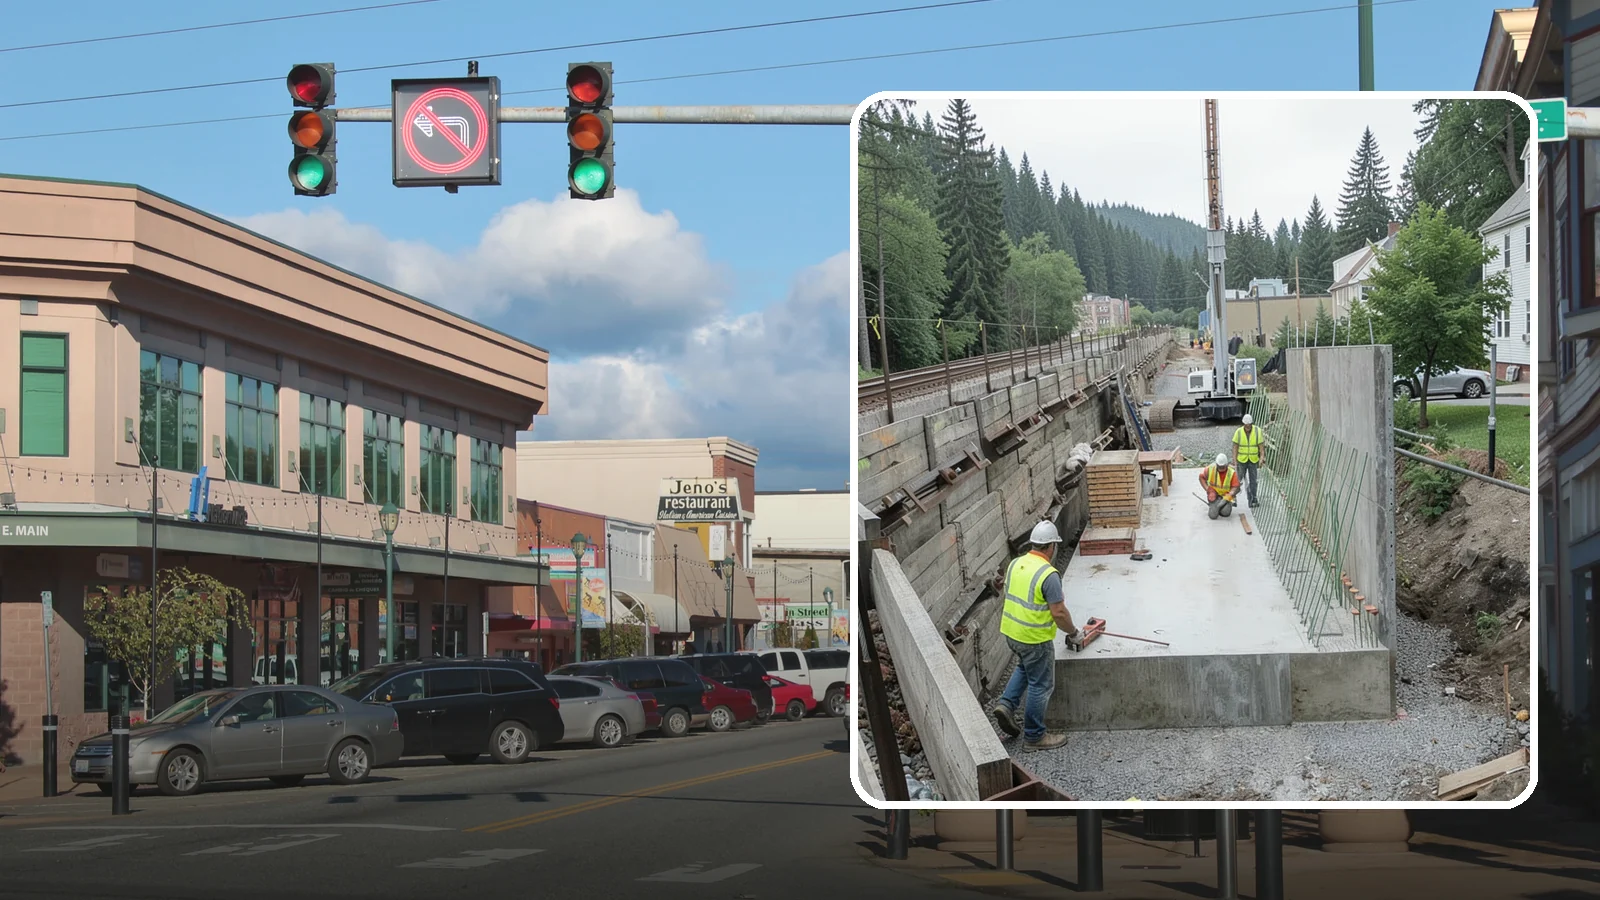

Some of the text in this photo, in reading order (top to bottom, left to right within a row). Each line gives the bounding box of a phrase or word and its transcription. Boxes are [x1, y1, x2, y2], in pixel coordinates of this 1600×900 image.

[670, 480, 727, 494] Jeno's
[665, 496, 731, 509] restaurant
[686, 510, 714, 519] American
[715, 509, 737, 519] Cuisine
[2, 525, 49, 536] E. MAIN
[797, 607, 828, 616] Street
